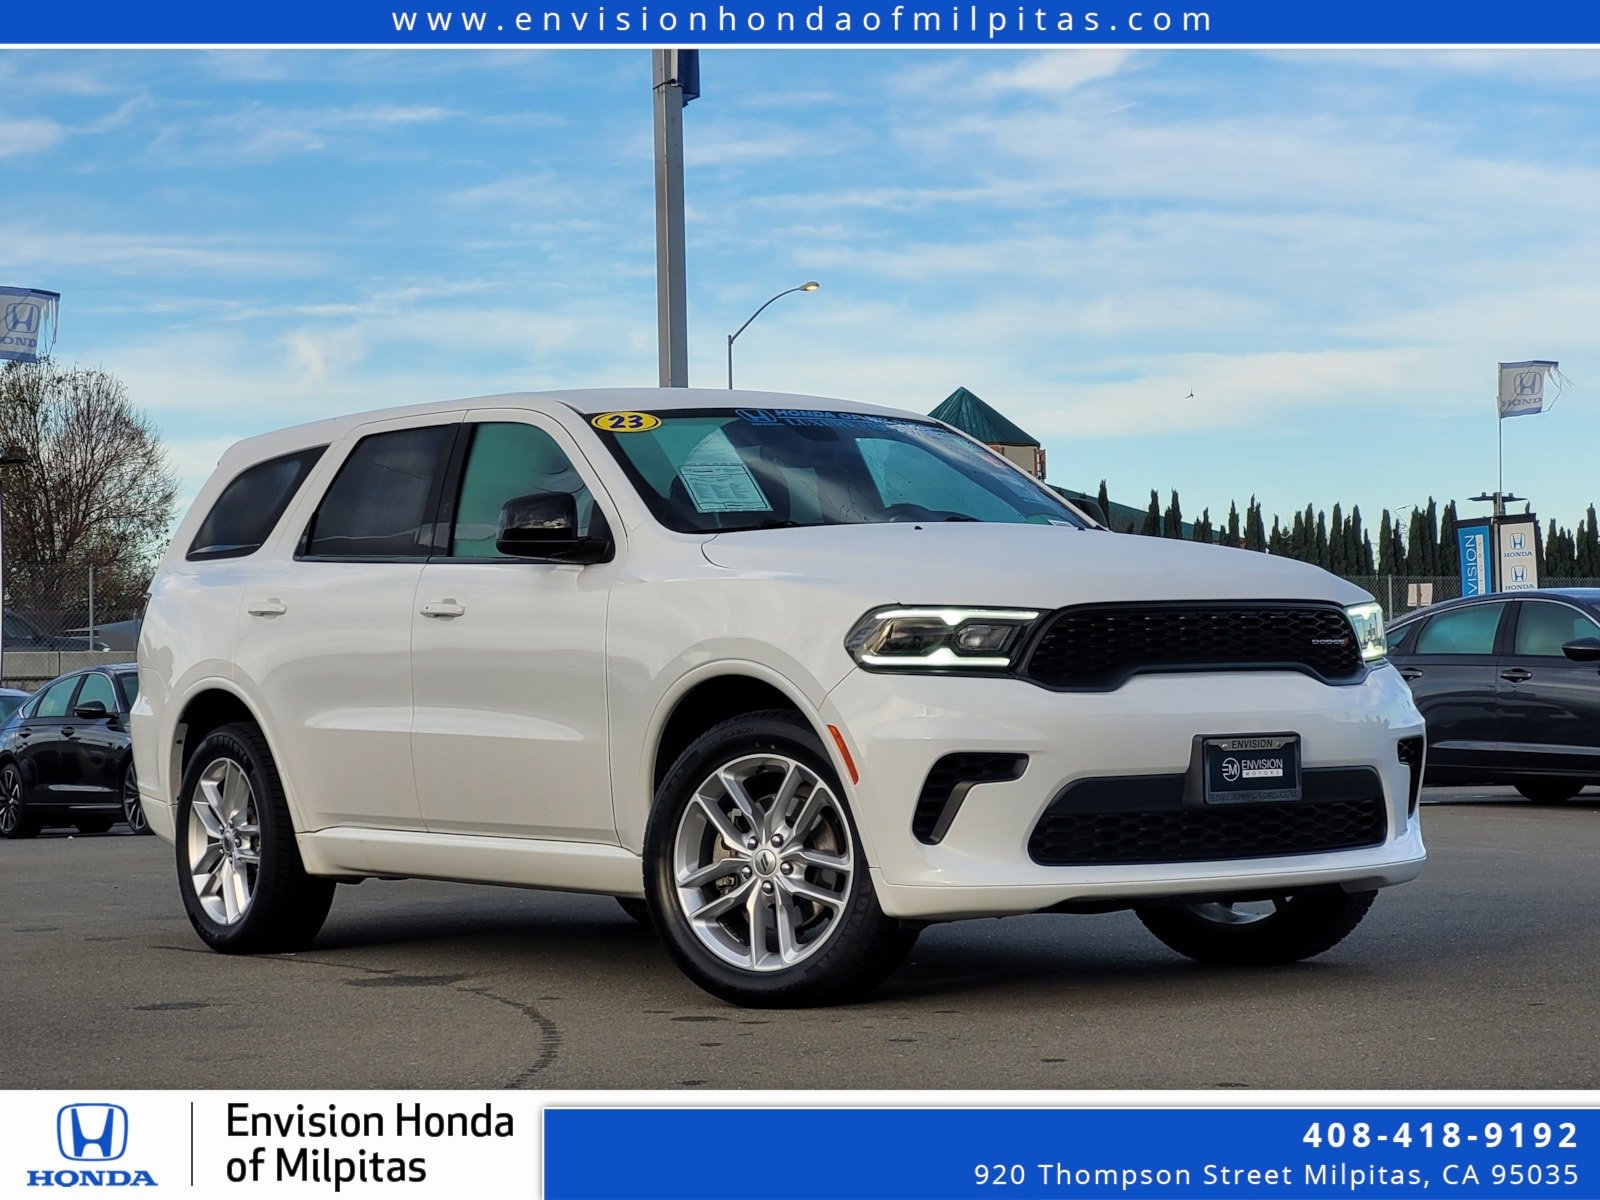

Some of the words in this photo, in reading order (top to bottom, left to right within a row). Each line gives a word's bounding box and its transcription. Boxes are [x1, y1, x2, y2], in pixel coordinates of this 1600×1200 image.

[775, 410, 836, 419] HONDA
[608, 415, 643, 429] 23
[1464, 535, 1477, 595] VISION
[1231, 739, 1273, 750] ENVISION
[1241, 759, 1283, 770] ENVISION
